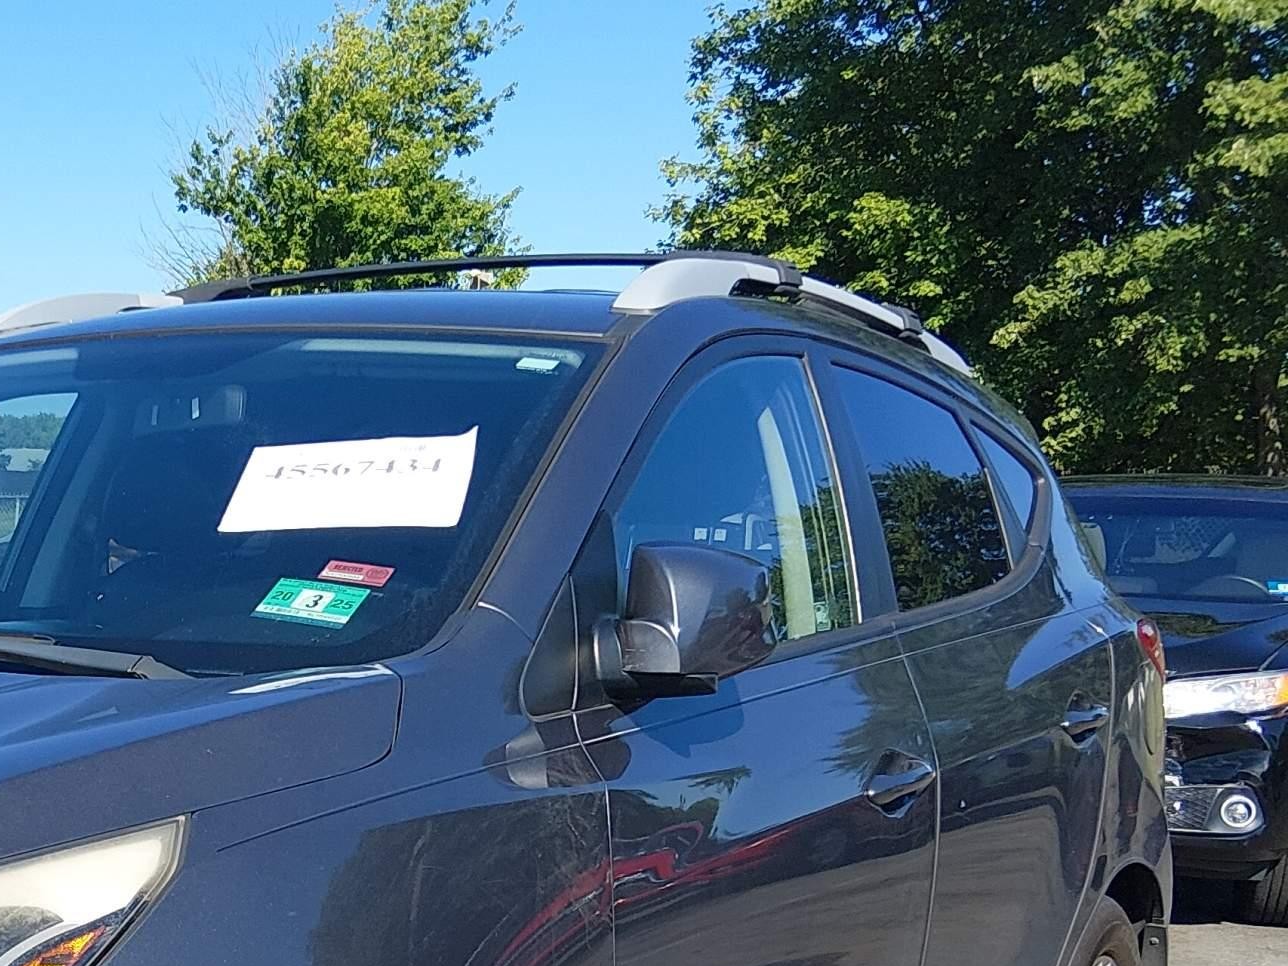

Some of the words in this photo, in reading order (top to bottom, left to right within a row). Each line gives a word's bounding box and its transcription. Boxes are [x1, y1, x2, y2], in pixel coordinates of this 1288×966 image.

[265, 458, 441, 479] 45567434
[270, 590, 295, 602] 20
[306, 594, 323, 609] 3
[331, 599, 355, 610] 25
